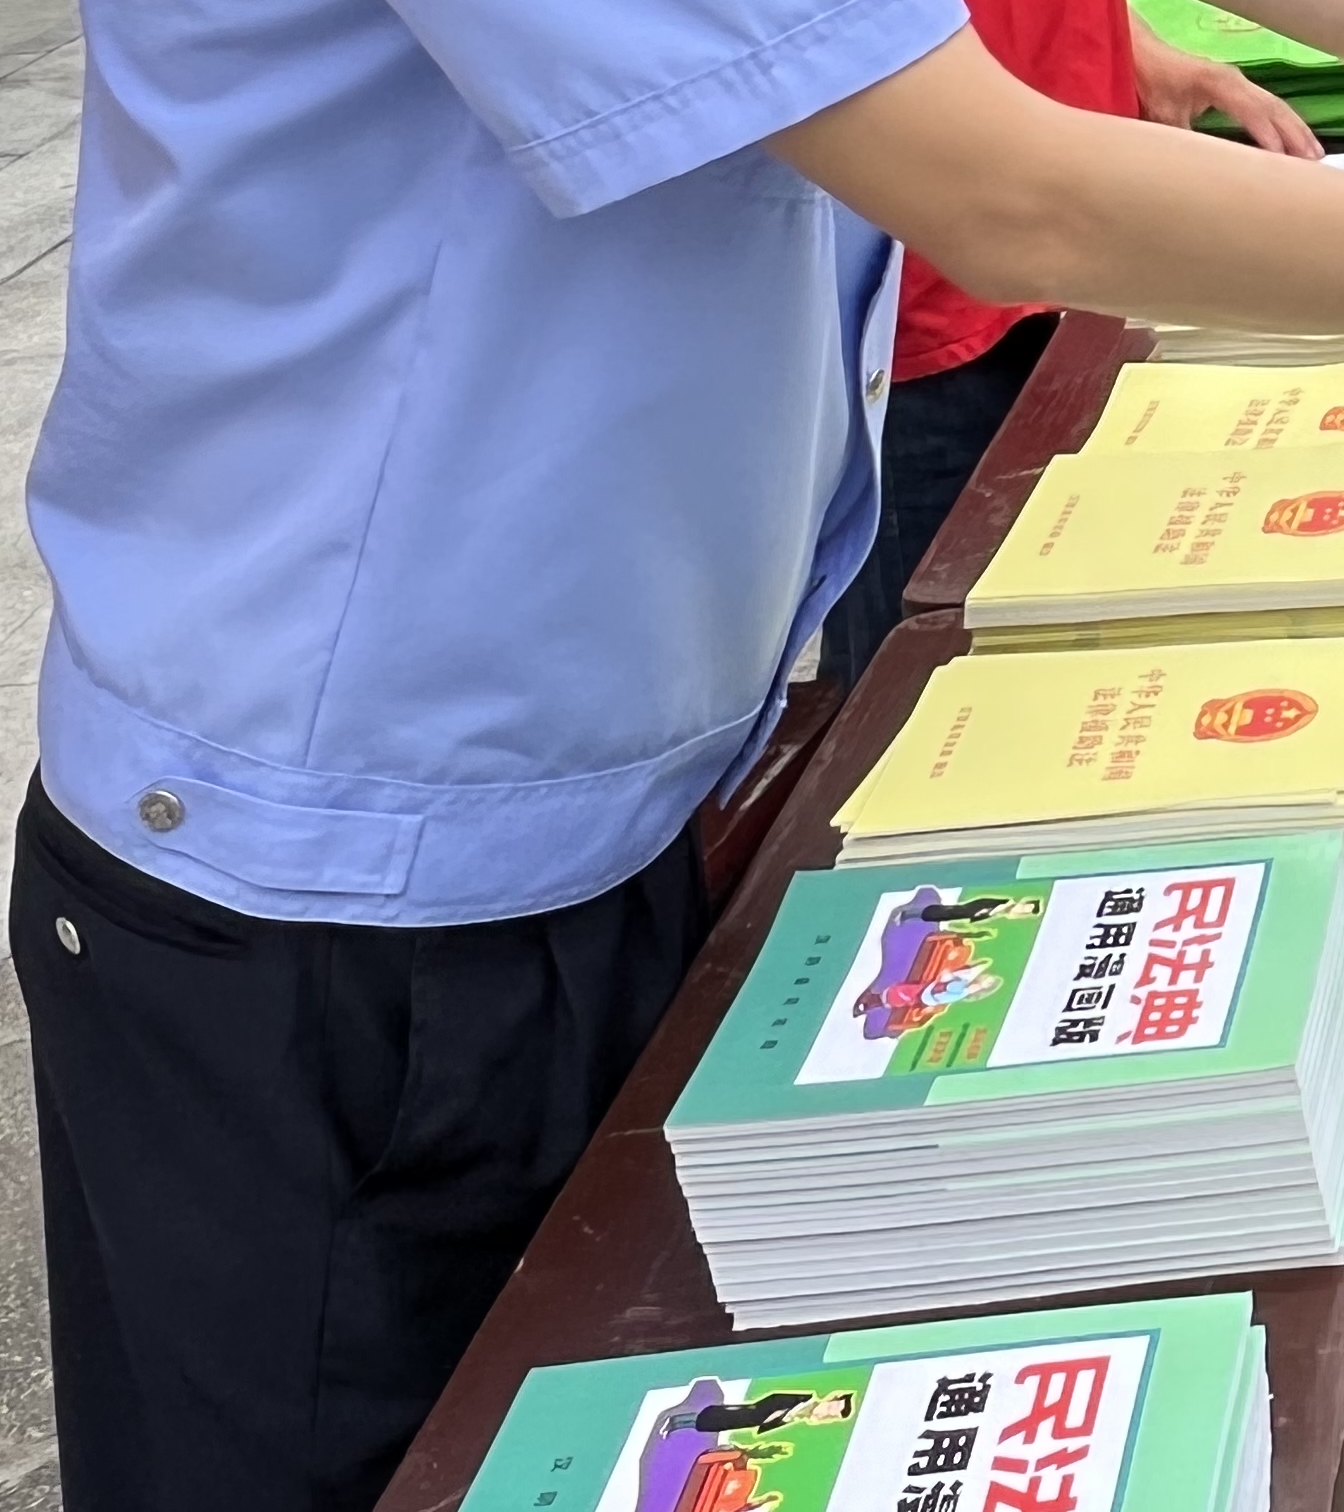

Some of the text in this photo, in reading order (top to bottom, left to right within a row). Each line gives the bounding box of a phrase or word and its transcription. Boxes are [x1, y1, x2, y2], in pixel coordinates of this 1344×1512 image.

[1180, 470, 1249, 567] 中华人民共和国
[1067, 686, 1126, 770] 法律援助法
[1101, 667, 1168, 783] 中华人民共和国
[1048, 885, 1137, 1050] 通用漫画版
[1114, 873, 1239, 1047] 民法典
